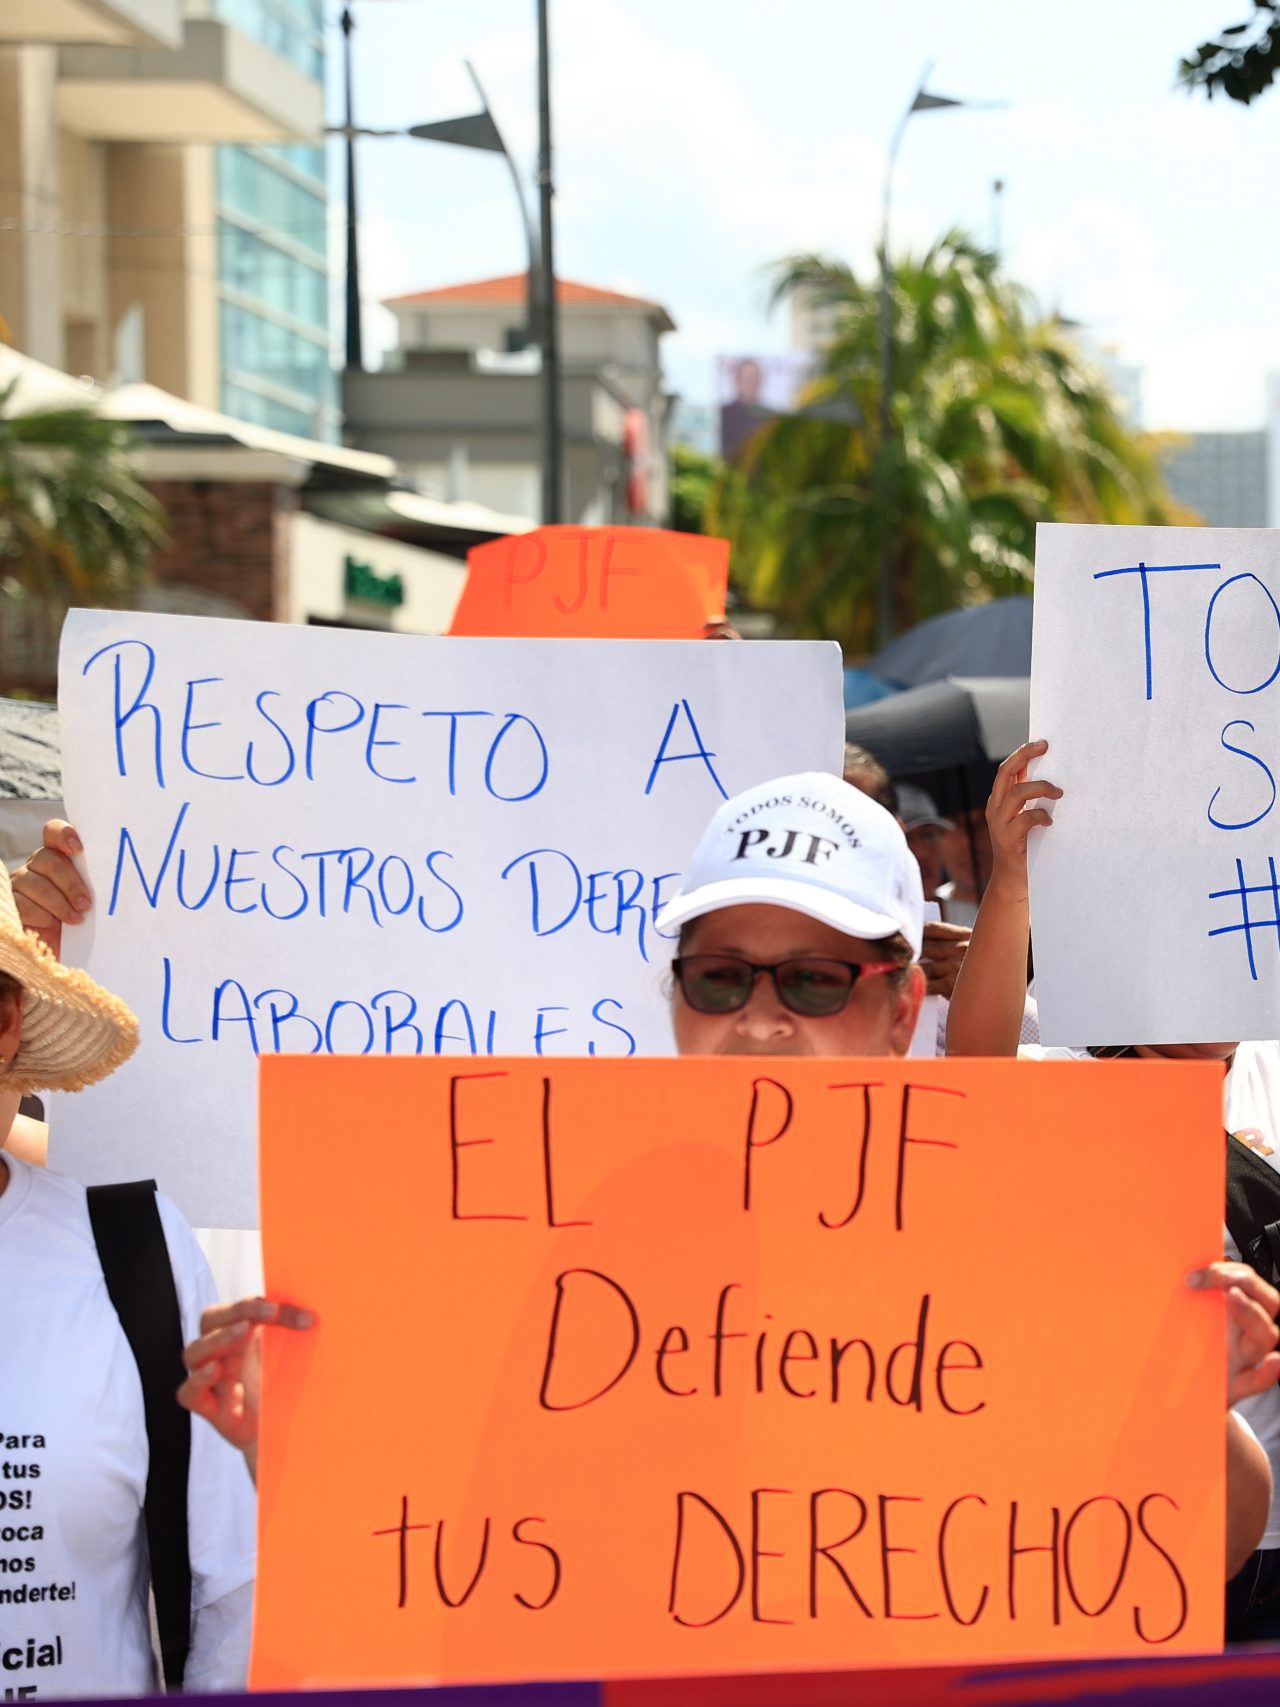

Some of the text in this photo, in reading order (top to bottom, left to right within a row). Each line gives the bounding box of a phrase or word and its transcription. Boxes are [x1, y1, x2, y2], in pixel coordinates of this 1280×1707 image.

[504, 532, 646, 615] PJF
[83, 640, 730, 802] RESPETO A
[107, 801, 465, 933] NUESTROS
[726, 795, 862, 849] TODOS SOMOS
[729, 828, 840, 867] PJF
[161, 957, 637, 1055] LABORALES
[450, 1072, 968, 1232] EL PJF
[539, 1268, 988, 1416] Defiende
[2, 1461, 41, 1480] tus
[0, 1525, 44, 1542] oca
[668, 1488, 1189, 1644] DERECHOS
[0, 1635, 63, 1671] cial
